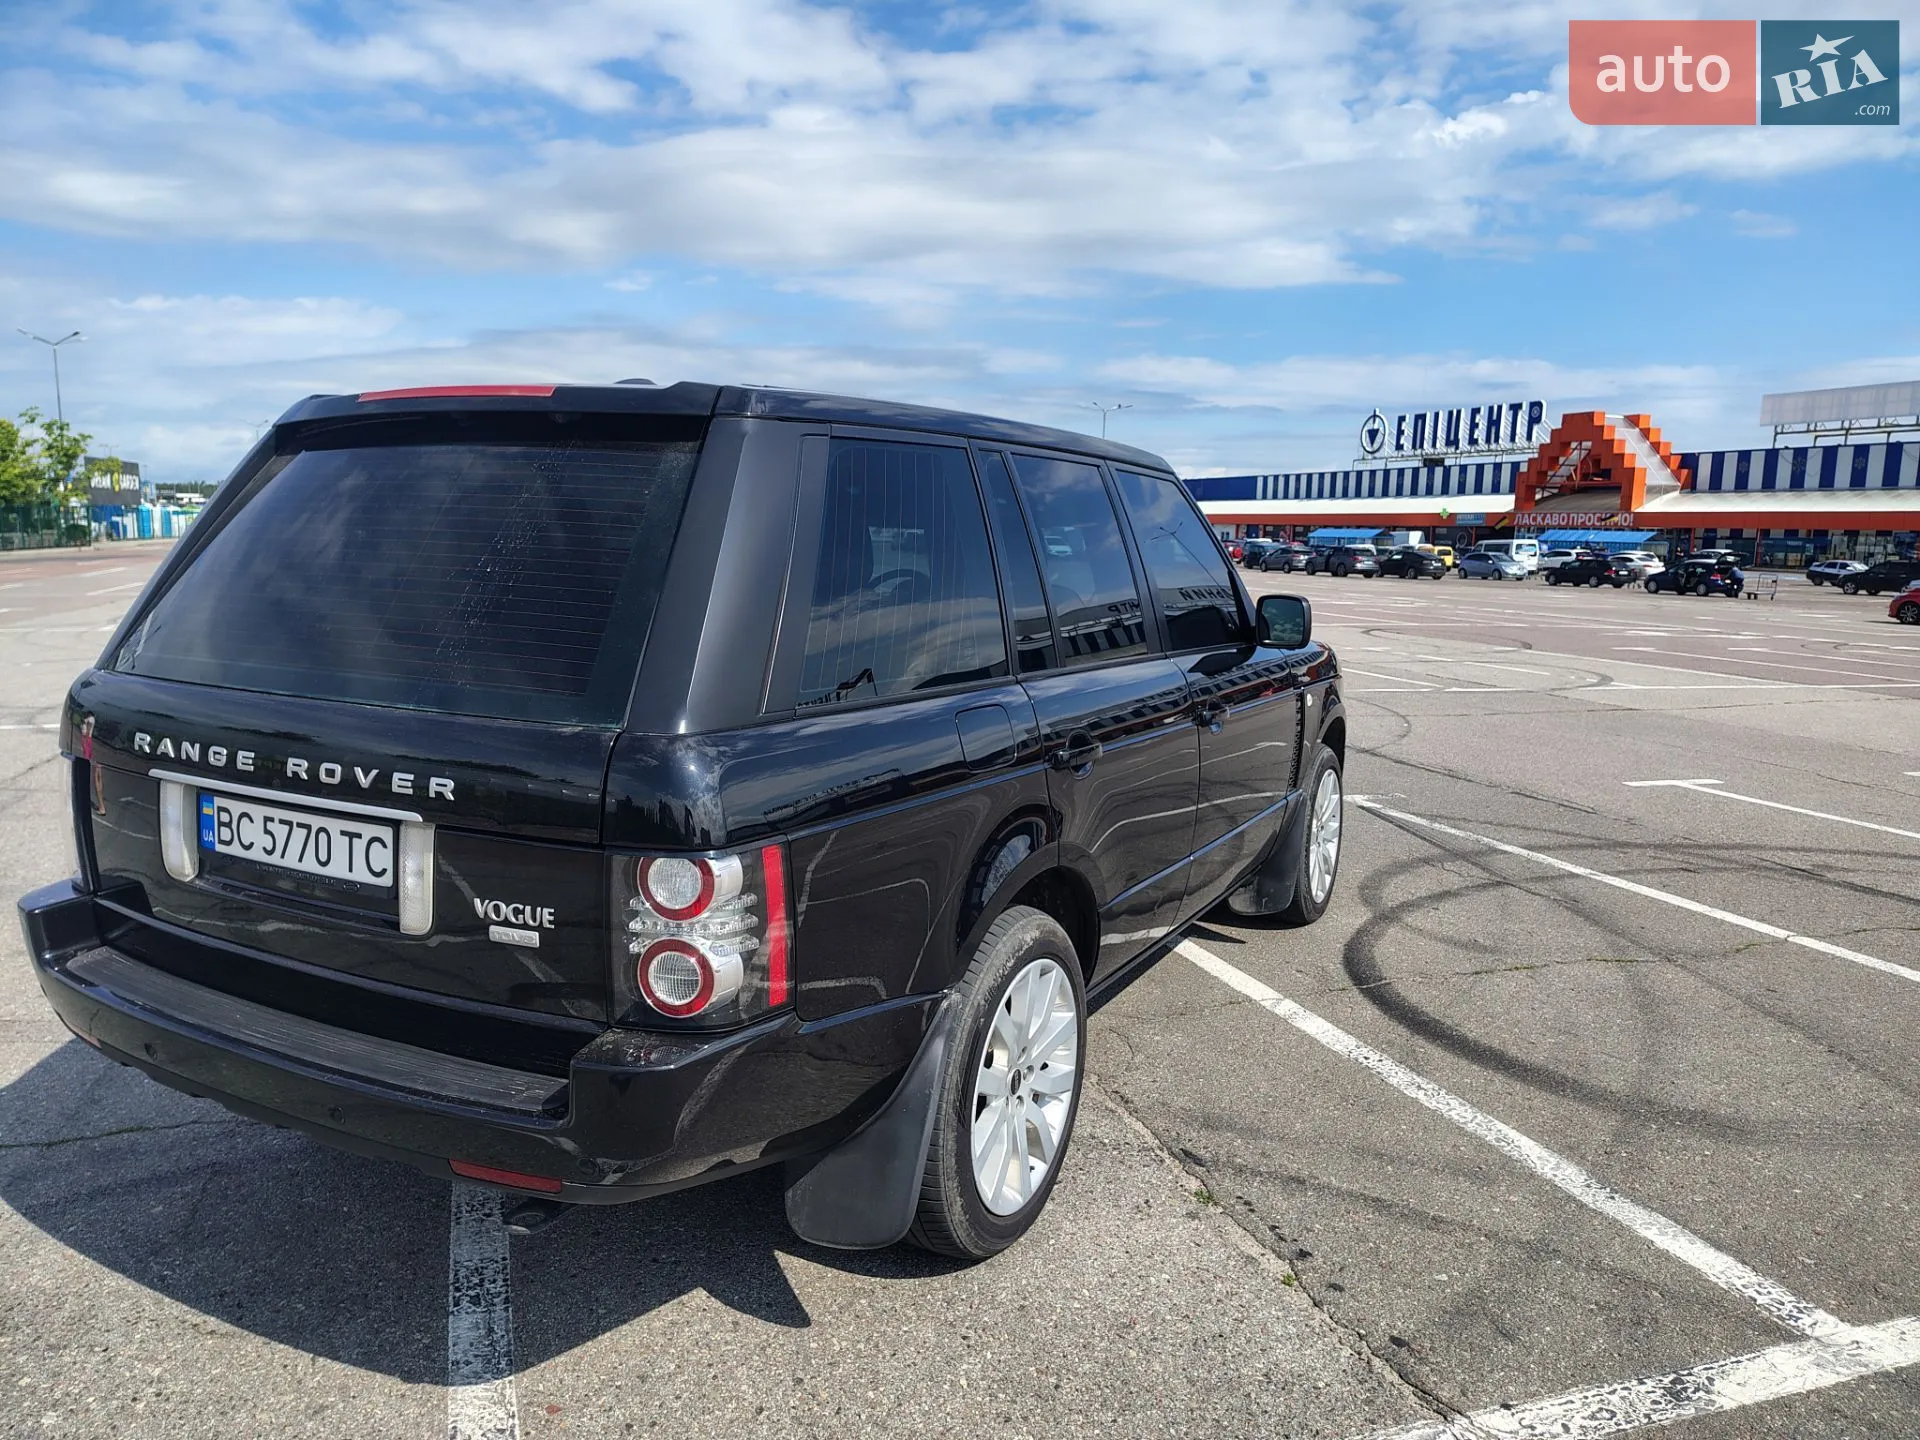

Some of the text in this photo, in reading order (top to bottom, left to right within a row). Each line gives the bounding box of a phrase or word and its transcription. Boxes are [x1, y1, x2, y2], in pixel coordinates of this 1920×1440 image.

[1395, 400, 1545, 450] ЕПІЦЕНТР
[1514, 513, 1568, 526] ЛАСКАВО
[133, 731, 455, 801] RANGE ROVER
[203, 829, 214, 843] UA
[216, 805, 255, 851] BC
[262, 815, 332, 867] 5770
[339, 829, 388, 878] TC
[473, 897, 555, 929] VOGUE
